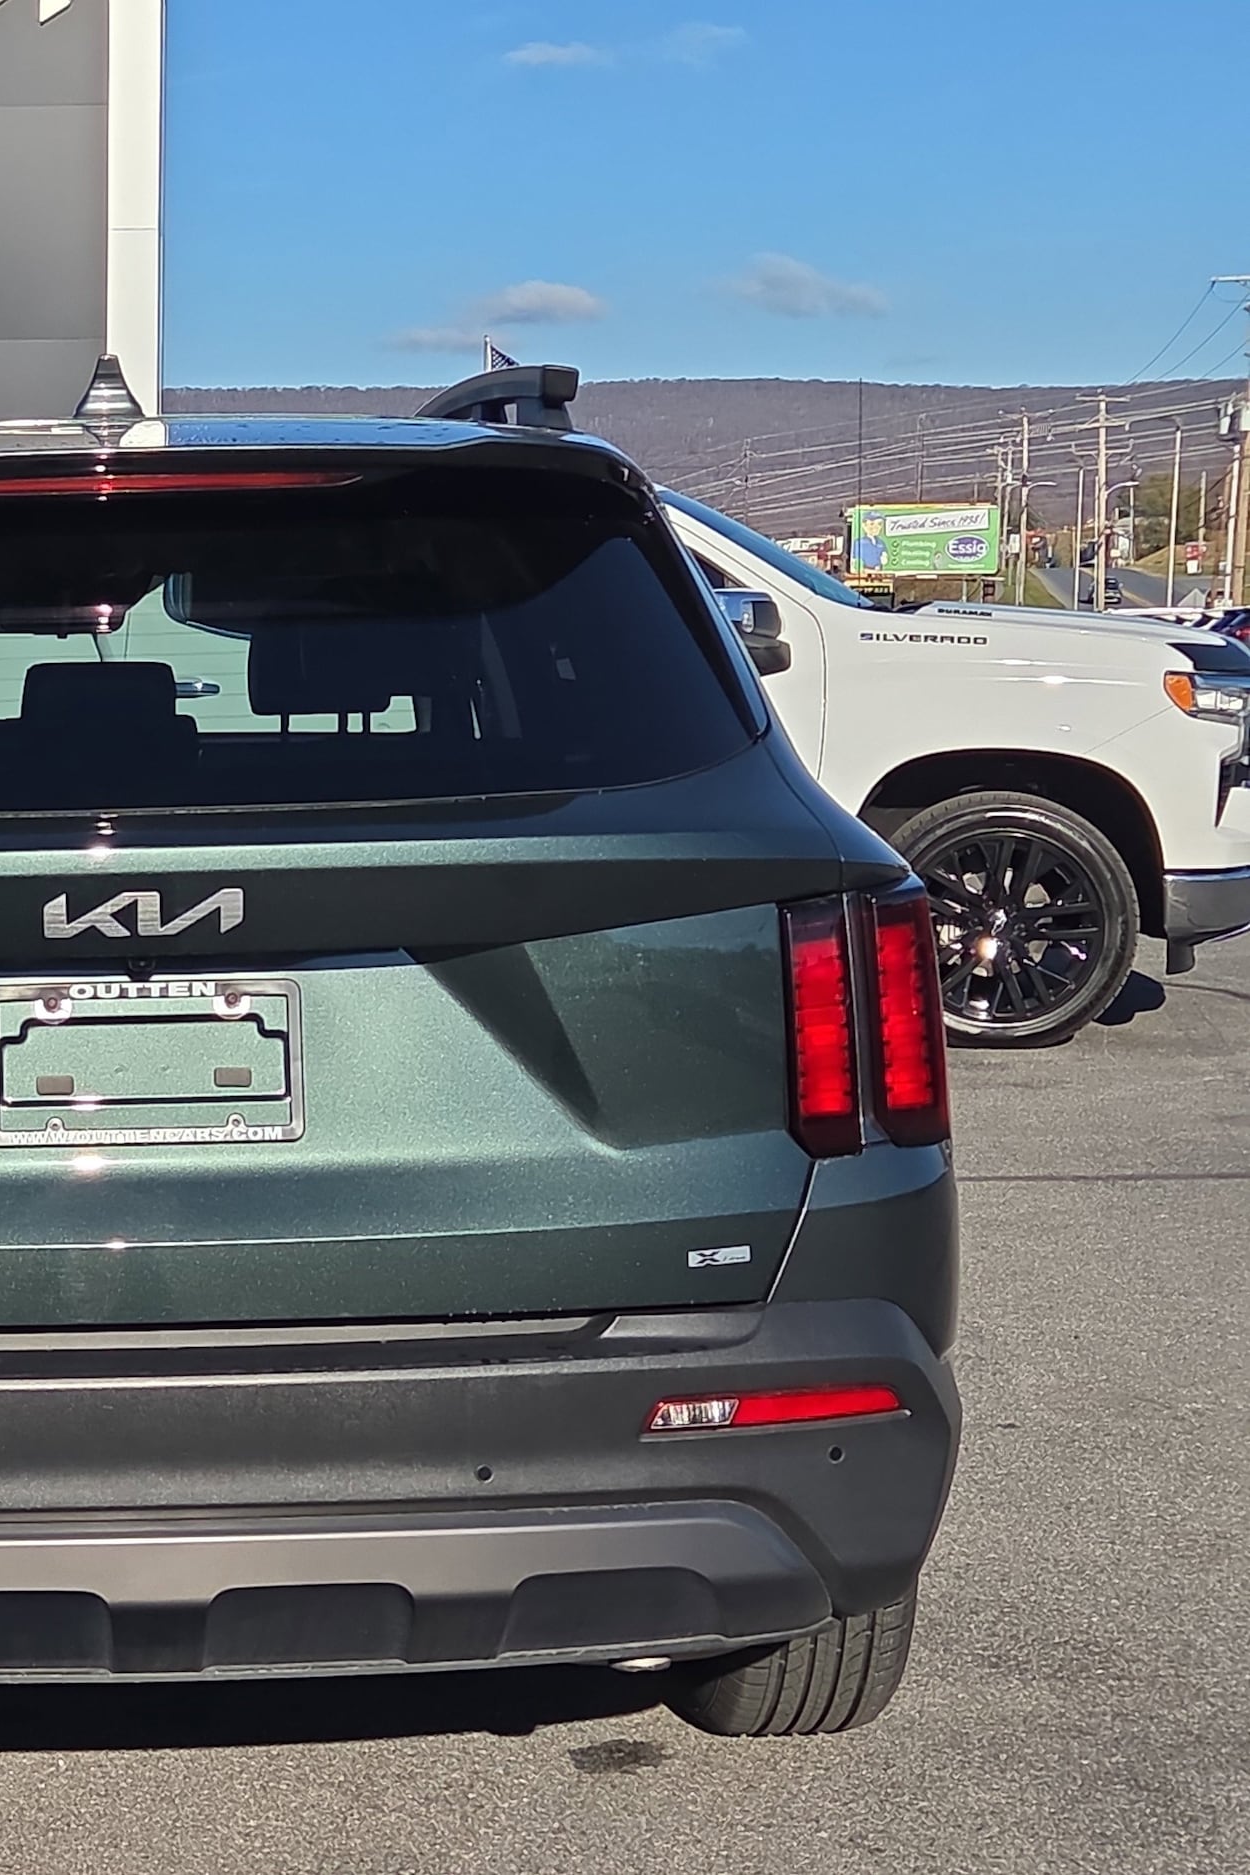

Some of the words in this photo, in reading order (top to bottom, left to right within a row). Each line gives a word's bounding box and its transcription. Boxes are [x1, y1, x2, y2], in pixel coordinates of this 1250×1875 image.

[889, 518, 927, 532] Trusted
[949, 539, 987, 558] Essig
[859, 633, 988, 645] SILVERADO
[43, 888, 244, 938] KIA
[68, 981, 217, 999] OUTTEN
